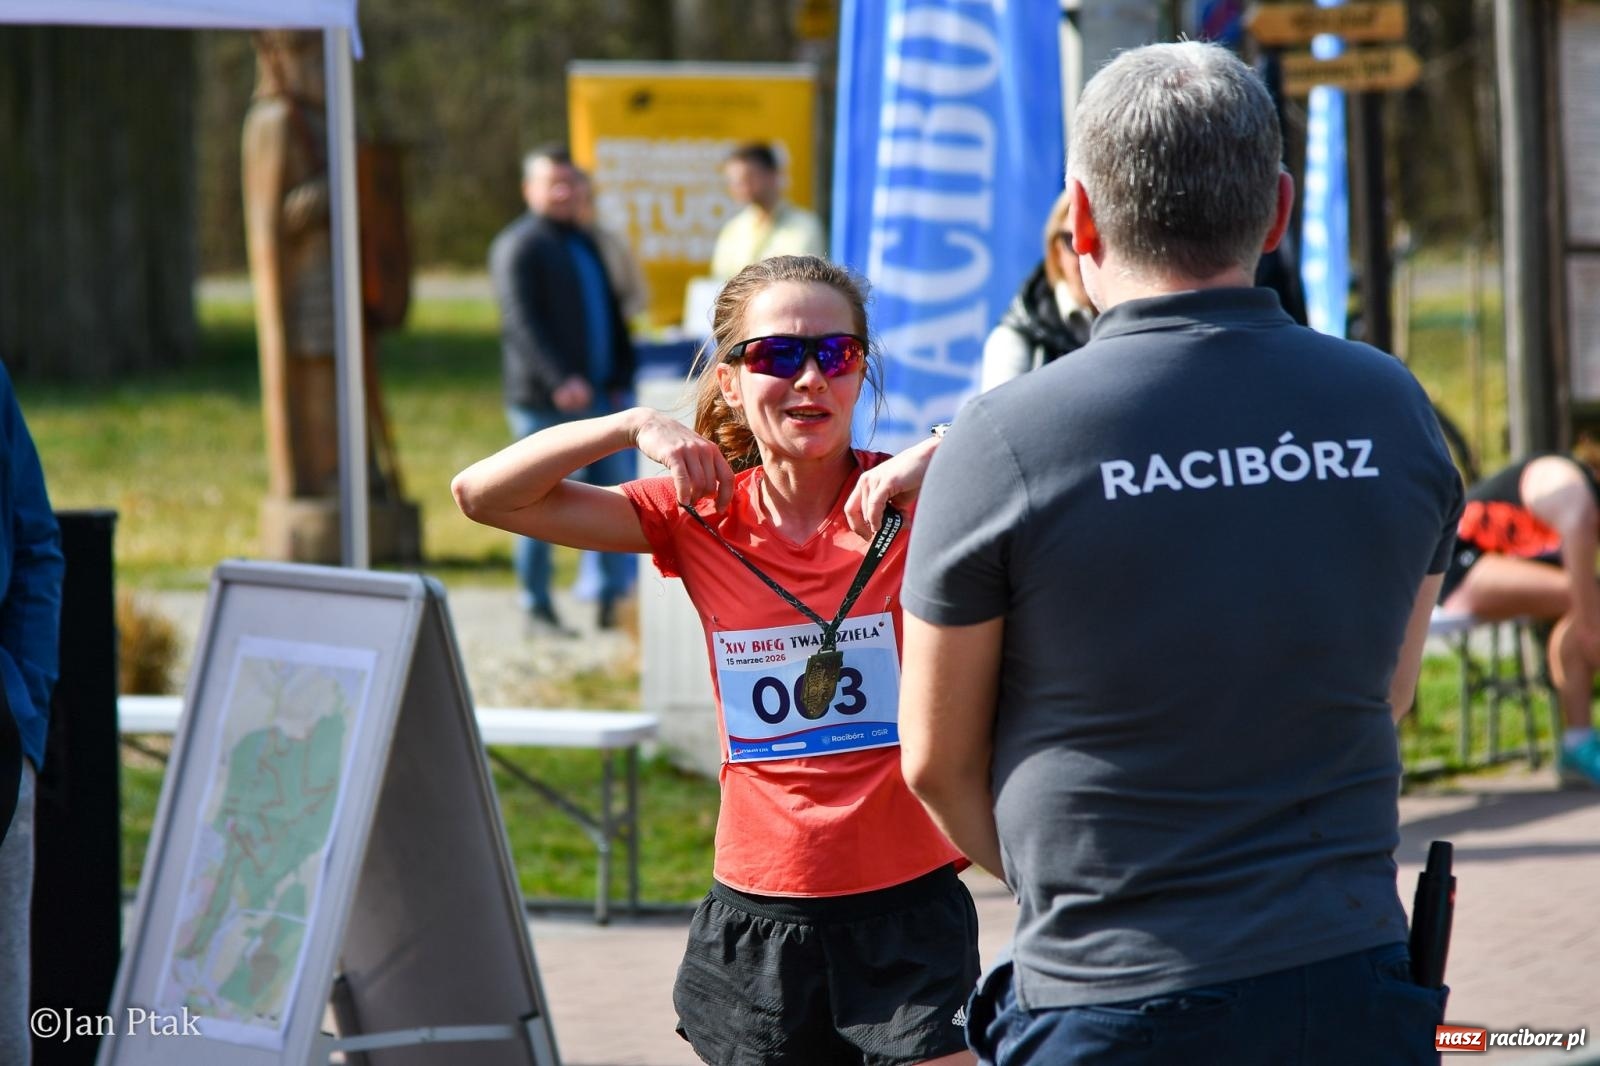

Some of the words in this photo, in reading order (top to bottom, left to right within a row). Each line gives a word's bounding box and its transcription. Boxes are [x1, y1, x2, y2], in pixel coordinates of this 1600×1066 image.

[868, 0, 1006, 448] RACIBO
[1100, 431, 1380, 500] RACIBÓRZ
[875, 535, 885, 549] XIV
[882, 517, 894, 535] BIEG
[725, 641, 746, 654] XIV
[752, 638, 785, 653] BIEG
[726, 657, 735, 666] 15
[735, 657, 764, 665] marzec
[765, 653, 786, 663] 2026
[831, 732, 865, 742] Racibórz
